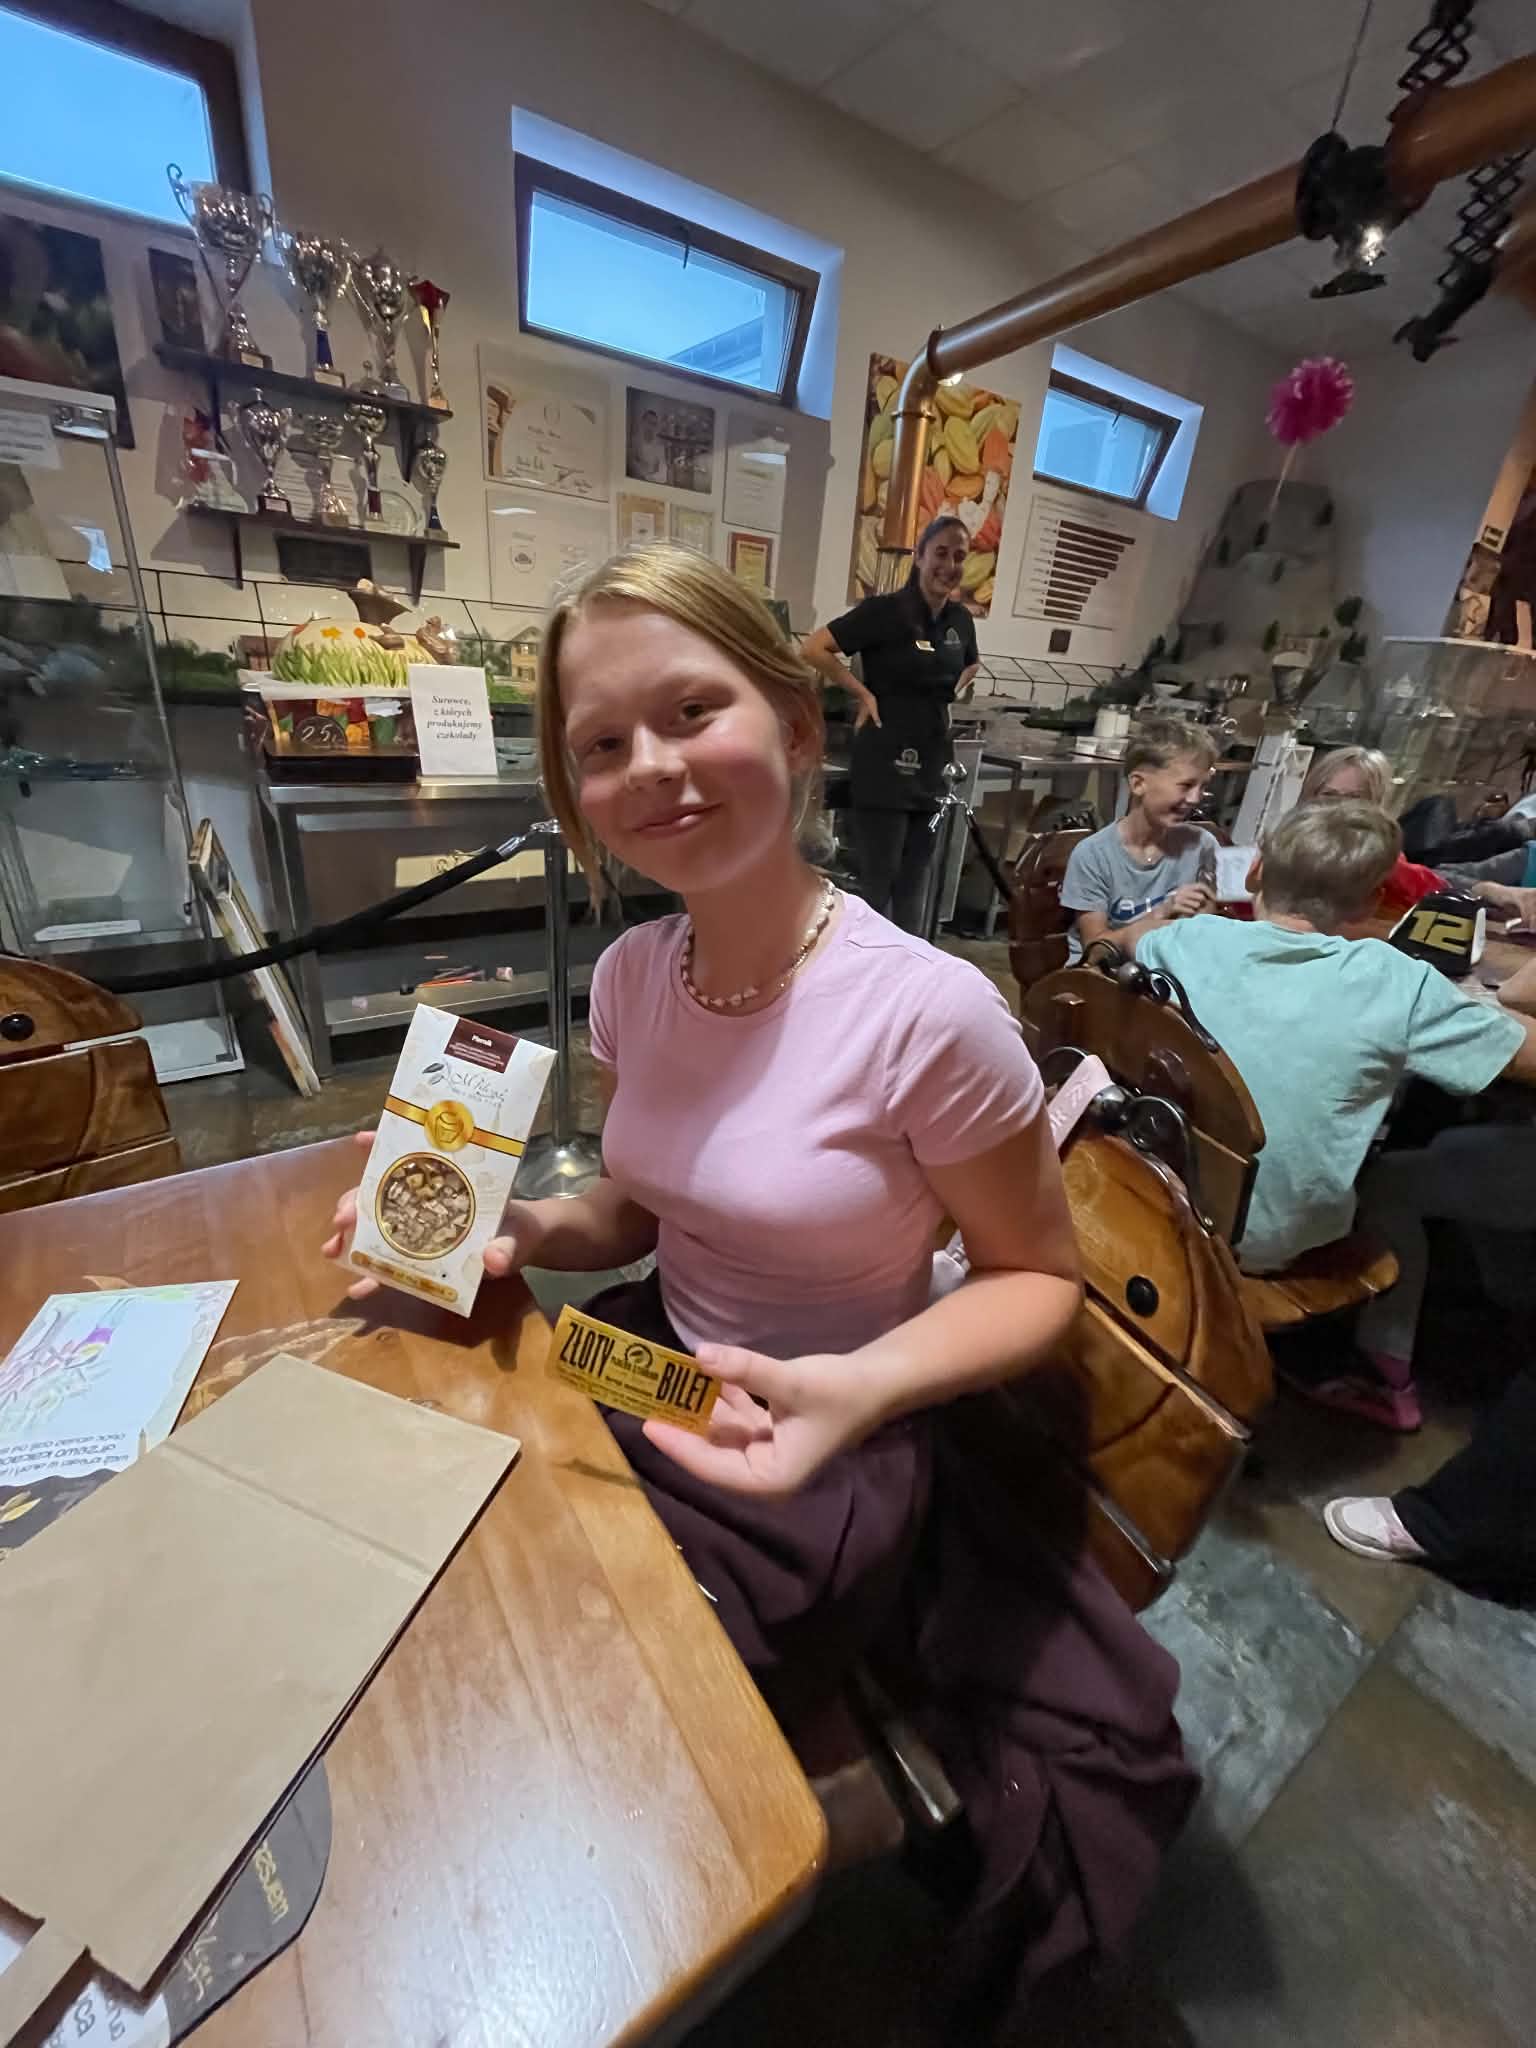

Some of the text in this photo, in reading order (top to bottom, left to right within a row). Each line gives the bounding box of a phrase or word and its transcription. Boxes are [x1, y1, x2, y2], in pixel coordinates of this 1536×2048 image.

[1408, 910, 1475, 956] 12
[560, 1322, 616, 1377] ZŁOTY
[656, 1362, 713, 1414] BILET
